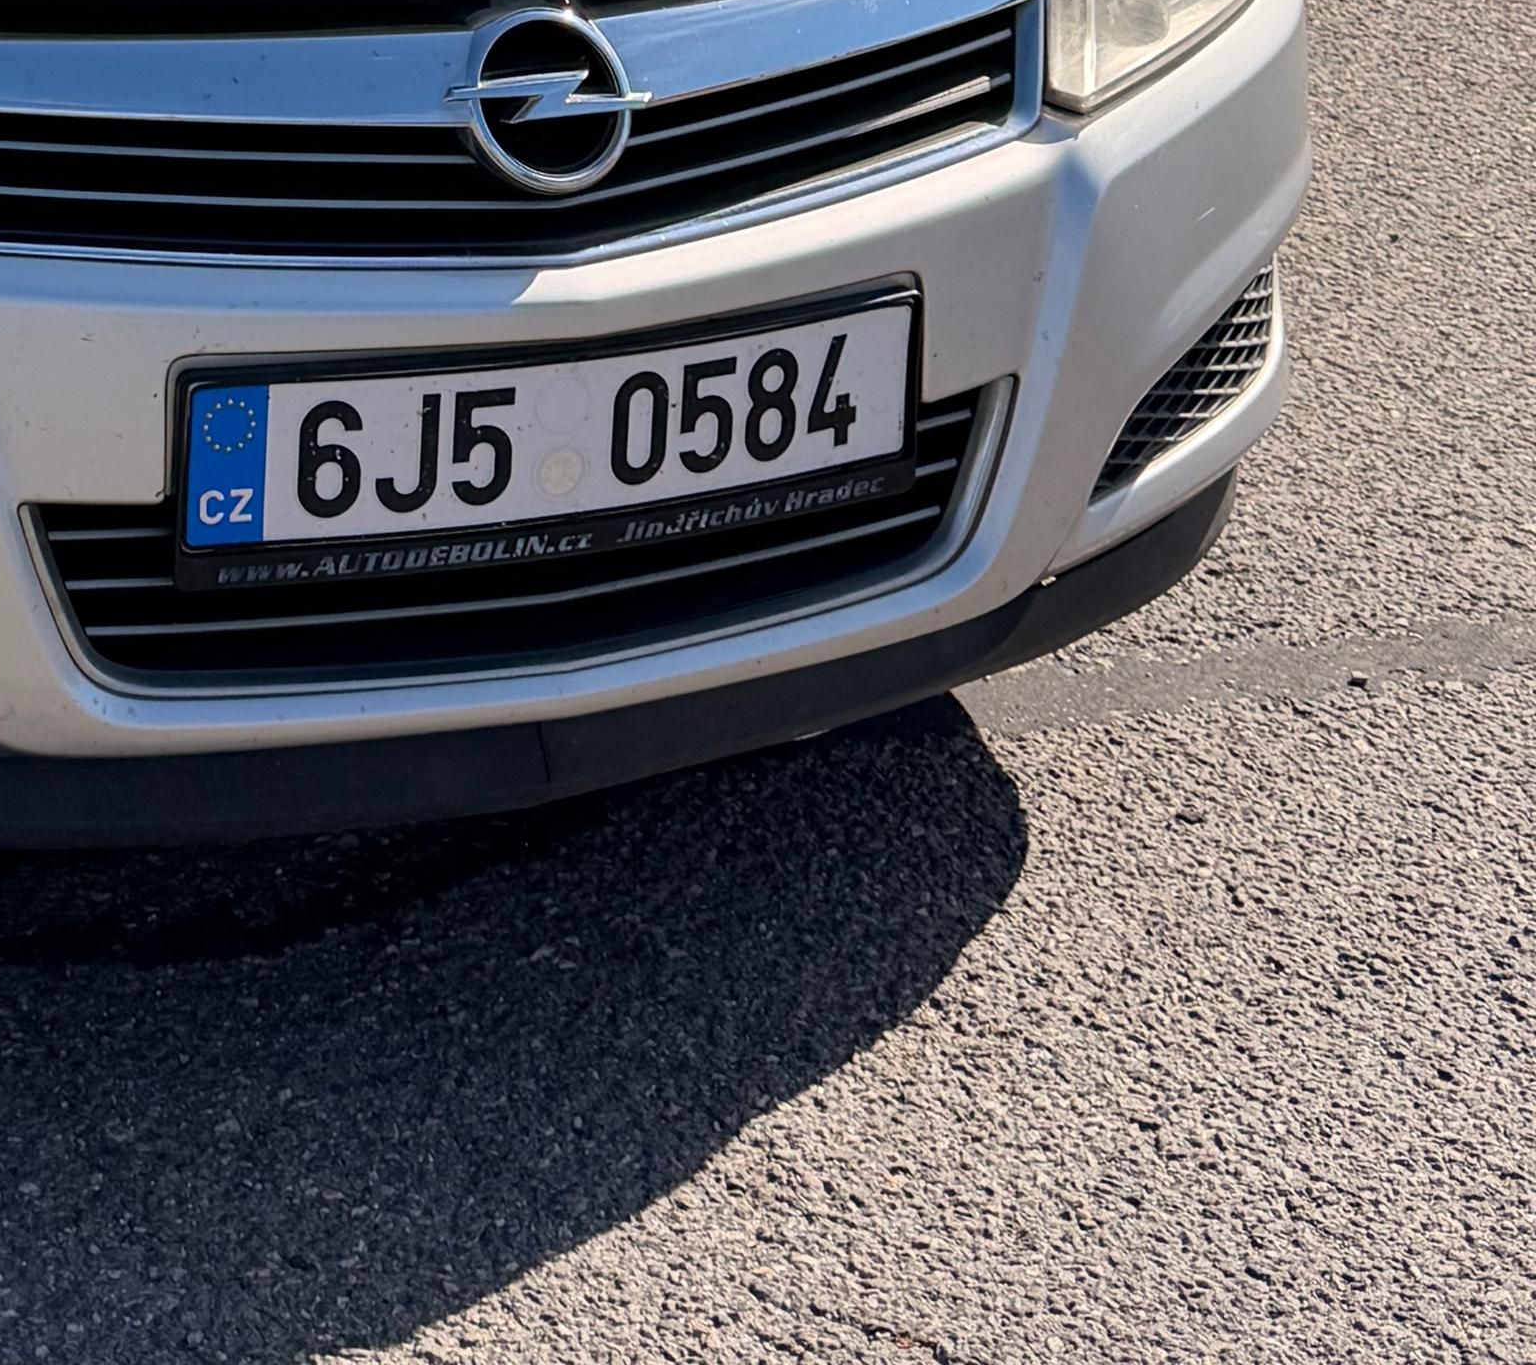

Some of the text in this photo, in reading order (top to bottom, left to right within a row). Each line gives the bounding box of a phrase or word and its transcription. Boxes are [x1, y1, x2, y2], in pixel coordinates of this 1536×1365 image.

[295, 332, 857, 520] 6J5 0584
[198, 485, 254, 525] CZ
[784, 476, 886, 513] Hradec
